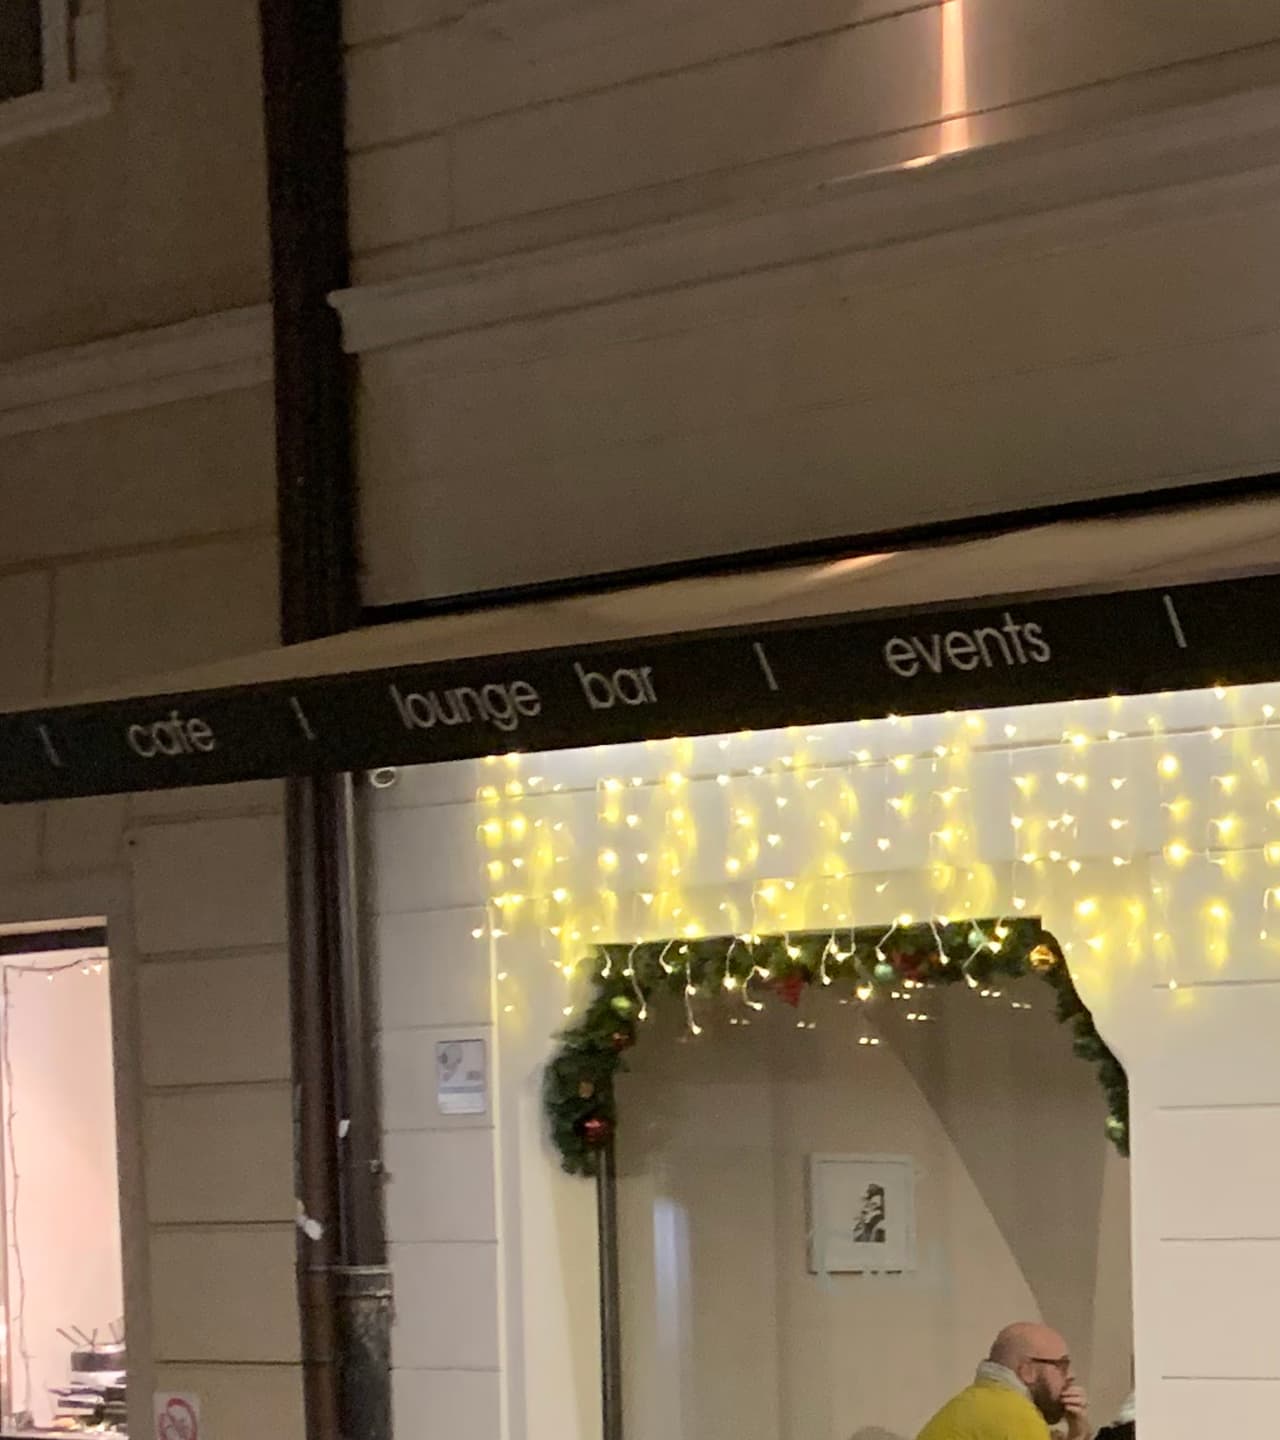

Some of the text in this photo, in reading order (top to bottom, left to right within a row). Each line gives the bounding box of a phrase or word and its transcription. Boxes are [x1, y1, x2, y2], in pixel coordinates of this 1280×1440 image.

[127, 709, 216, 759] cafe
[389, 684, 542, 732] lounge
[574, 662, 660, 708] bar
[885, 612, 1052, 679] events
